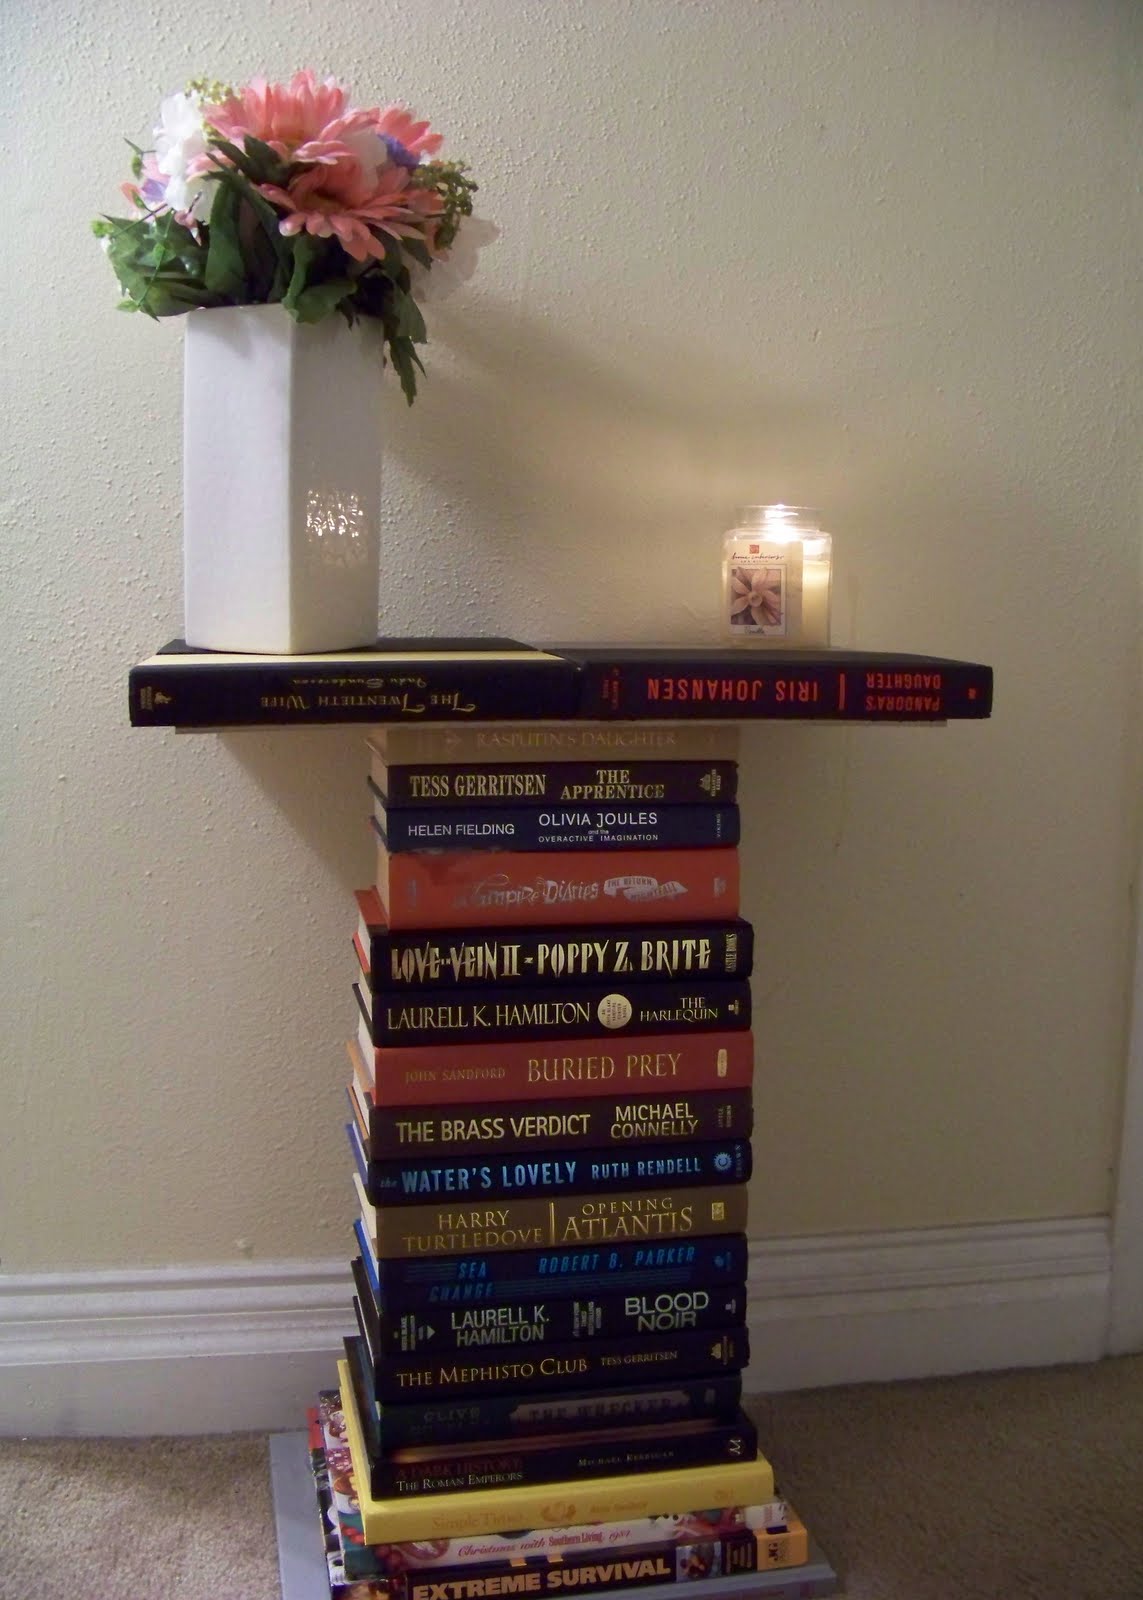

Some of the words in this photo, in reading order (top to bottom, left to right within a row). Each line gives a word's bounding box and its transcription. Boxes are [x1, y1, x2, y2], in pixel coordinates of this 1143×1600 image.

[646, 677, 763, 701] JOHANSEN
[775, 681, 819, 701] IRIS
[866, 672, 942, 689] DAUGHTER
[865, 693, 941, 712] PANDORA'S
[410, 774, 449, 797] TESS
[455, 773, 546, 797] GERRITSEN
[596, 769, 630, 784] THE
[560, 784, 665, 800] APPRENTICE
[408, 824, 452, 837] HELEN
[455, 823, 515, 837] FIELDING
[538, 813, 591, 827] OLIVIA
[596, 812, 658, 828] JOULES
[538, 835, 594, 843] OVERACTIVE
[600, 834, 658, 842] IMAGINATION
[725, 933, 738, 951] BOOKS
[391, 941, 441, 983] LOVE
[450, 941, 498, 983] VEIN
[537, 939, 610, 978] POPPY
[641, 938, 711, 977] BRITE
[725, 951, 737, 973] CASTLE
[680, 997, 707, 1009] THE
[387, 1005, 468, 1030] LAURELL
[473, 1005, 491, 1027] K.
[496, 1001, 591, 1026] HAMILTON
[640, 1008, 719, 1023] HARLEQUIN
[405, 1070, 437, 1084] JOHN
[442, 1067, 506, 1082] SANDFORD
[527, 1055, 615, 1083] BURIED
[626, 1053, 683, 1078] PREY
[615, 1102, 694, 1122] MICHAEL
[396, 1121, 434, 1143] THE
[441, 1117, 505, 1142] BRASS
[510, 1114, 591, 1138] VERDICT
[610, 1119, 699, 1139] CONNELLY
[401, 1166, 492, 1194] WATER'S
[502, 1161, 577, 1188] LOVELY
[591, 1161, 630, 1180] RUTH
[637, 1157, 701, 1177] RENDELL
[582, 1197, 673, 1217] OPENING
[438, 1209, 510, 1231] HARRY
[561, 1206, 693, 1242] ATLANTIS
[402, 1227, 542, 1253] TURTLEDOVE
[458, 1261, 487, 1280] SEA
[538, 1253, 600, 1275] ROBERT
[609, 1252, 623, 1269] B.
[635, 1246, 696, 1266] PARKER
[625, 1291, 710, 1316] BLOOD
[451, 1306, 528, 1330] LAURELL
[534, 1305, 550, 1322] K.
[637, 1311, 697, 1333] NOIR
[456, 1324, 545, 1347] HAMILTON
[396, 1371, 432, 1388] THE
[439, 1362, 534, 1385] MEPHISTO
[540, 1357, 587, 1375] CLUB
[601, 1355, 622, 1367] TESS
[623, 1350, 678, 1365] GERRITSEN
[395, 1480, 419, 1492] THE
[423, 1477, 464, 1490] ROMAN
[468, 1471, 523, 1486] EMPERORS
[458, 1543, 516, 1558] Christmas
[520, 1537, 546, 1550] with
[549, 1535, 580, 1547] Southern
[581, 1531, 603, 1544] Living
[413, 1572, 541, 1600] EXTREME
[547, 1558, 671, 1588] SURVIVAL
